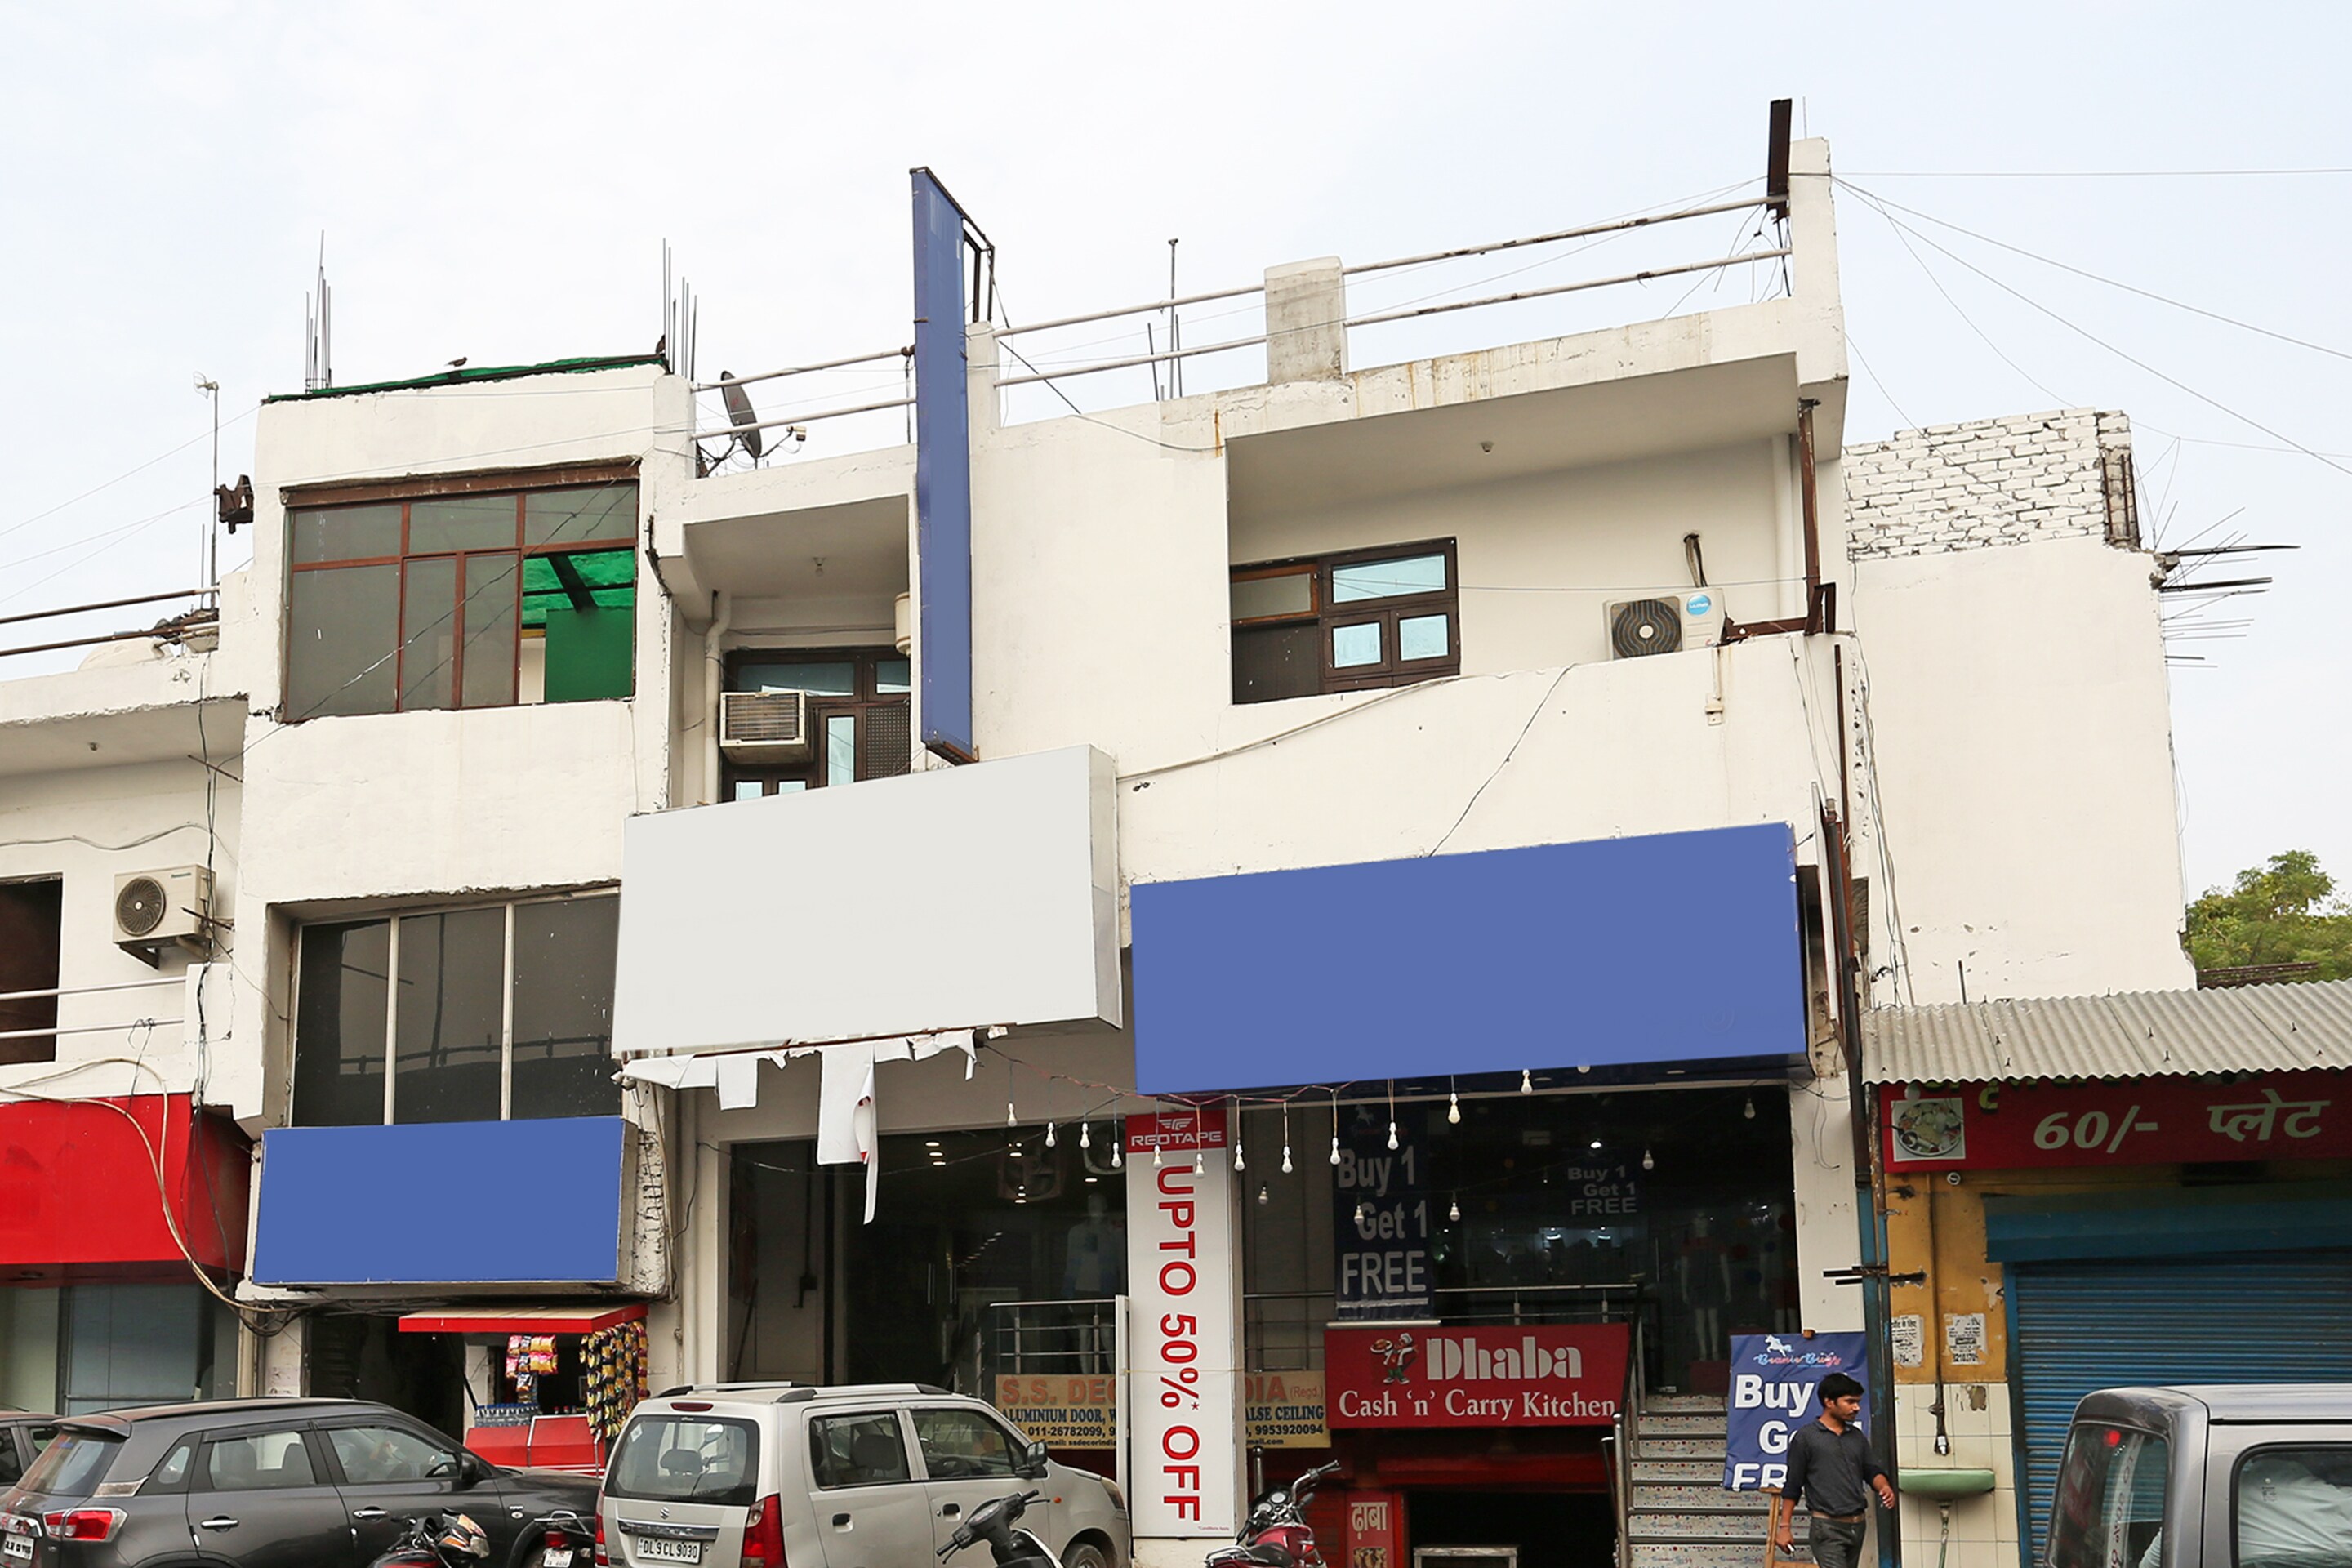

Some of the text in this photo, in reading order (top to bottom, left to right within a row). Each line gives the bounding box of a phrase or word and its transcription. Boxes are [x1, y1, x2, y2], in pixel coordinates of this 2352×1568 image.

[2033, 1089, 2331, 1153] 60/- प्लेट
[1338, 1145, 1414, 1197] Buy 1
[1568, 1165, 1626, 1182] Buy 1
[1583, 1181, 1636, 1196] Get 1
[1356, 1199, 1428, 1241] Get 1
[1570, 1197, 1637, 1216] FREE
[1157, 1165, 1197, 1296] UPTO
[1342, 1250, 1427, 1295] FREE
[1426, 1336, 1583, 1380] Dhaba
[1002, 1378, 1058, 1405] S.S.
[1339, 1390, 1399, 1418] Cash
[1445, 1388, 1514, 1421] Carry
[1521, 1391, 1615, 1418] Kitchen
[1735, 1374, 1815, 1418] Buy
[1245, 1405, 1324, 1421] ALSE CEILING
[1255, 1424, 1324, 1436] 9953920094
[1162, 1425, 1200, 1521] OFF
[1731, 1463, 1788, 1492] FR
